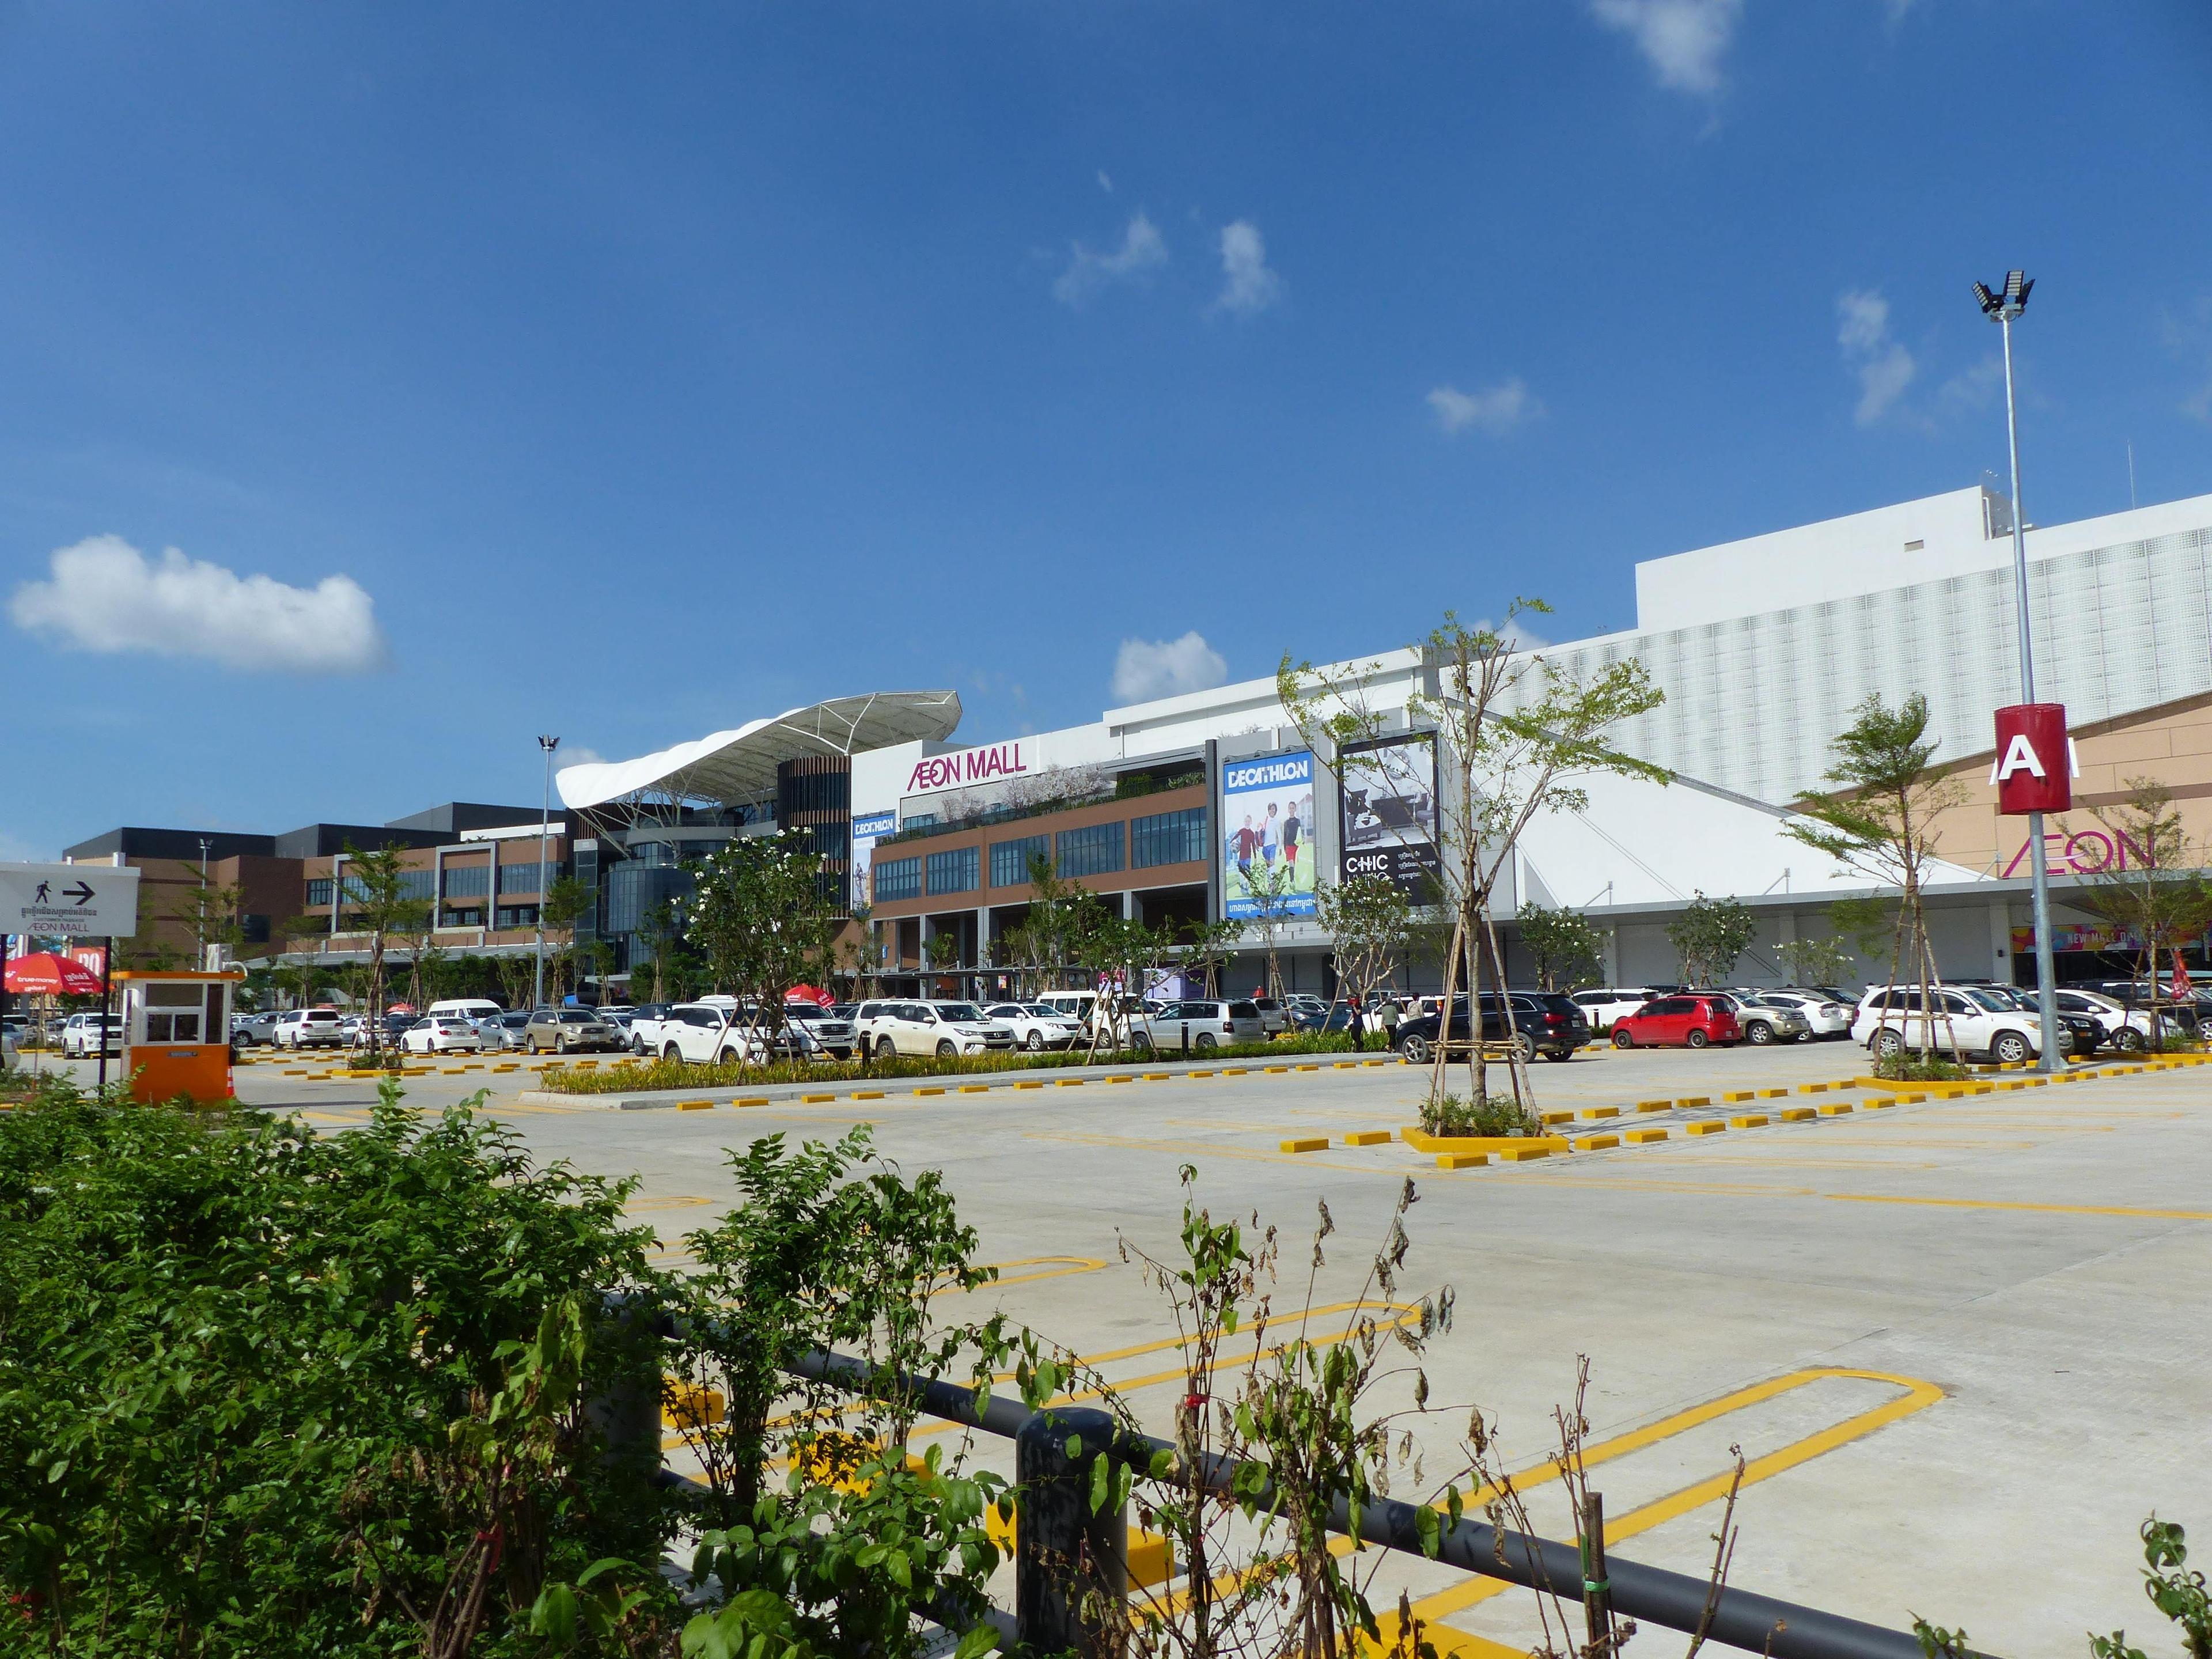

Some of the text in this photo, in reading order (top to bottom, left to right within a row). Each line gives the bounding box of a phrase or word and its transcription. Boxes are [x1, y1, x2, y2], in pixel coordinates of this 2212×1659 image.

[967, 744, 1027, 780] MALL
[1998, 735, 2046, 780] A
[1228, 760, 1308, 788] DECATHLON
[855, 819, 893, 835] DECATHLON
[1346, 854, 1388, 873] CHIC
[60, 923, 89, 931] MALL
[2067, 933, 2087, 944] NEW
